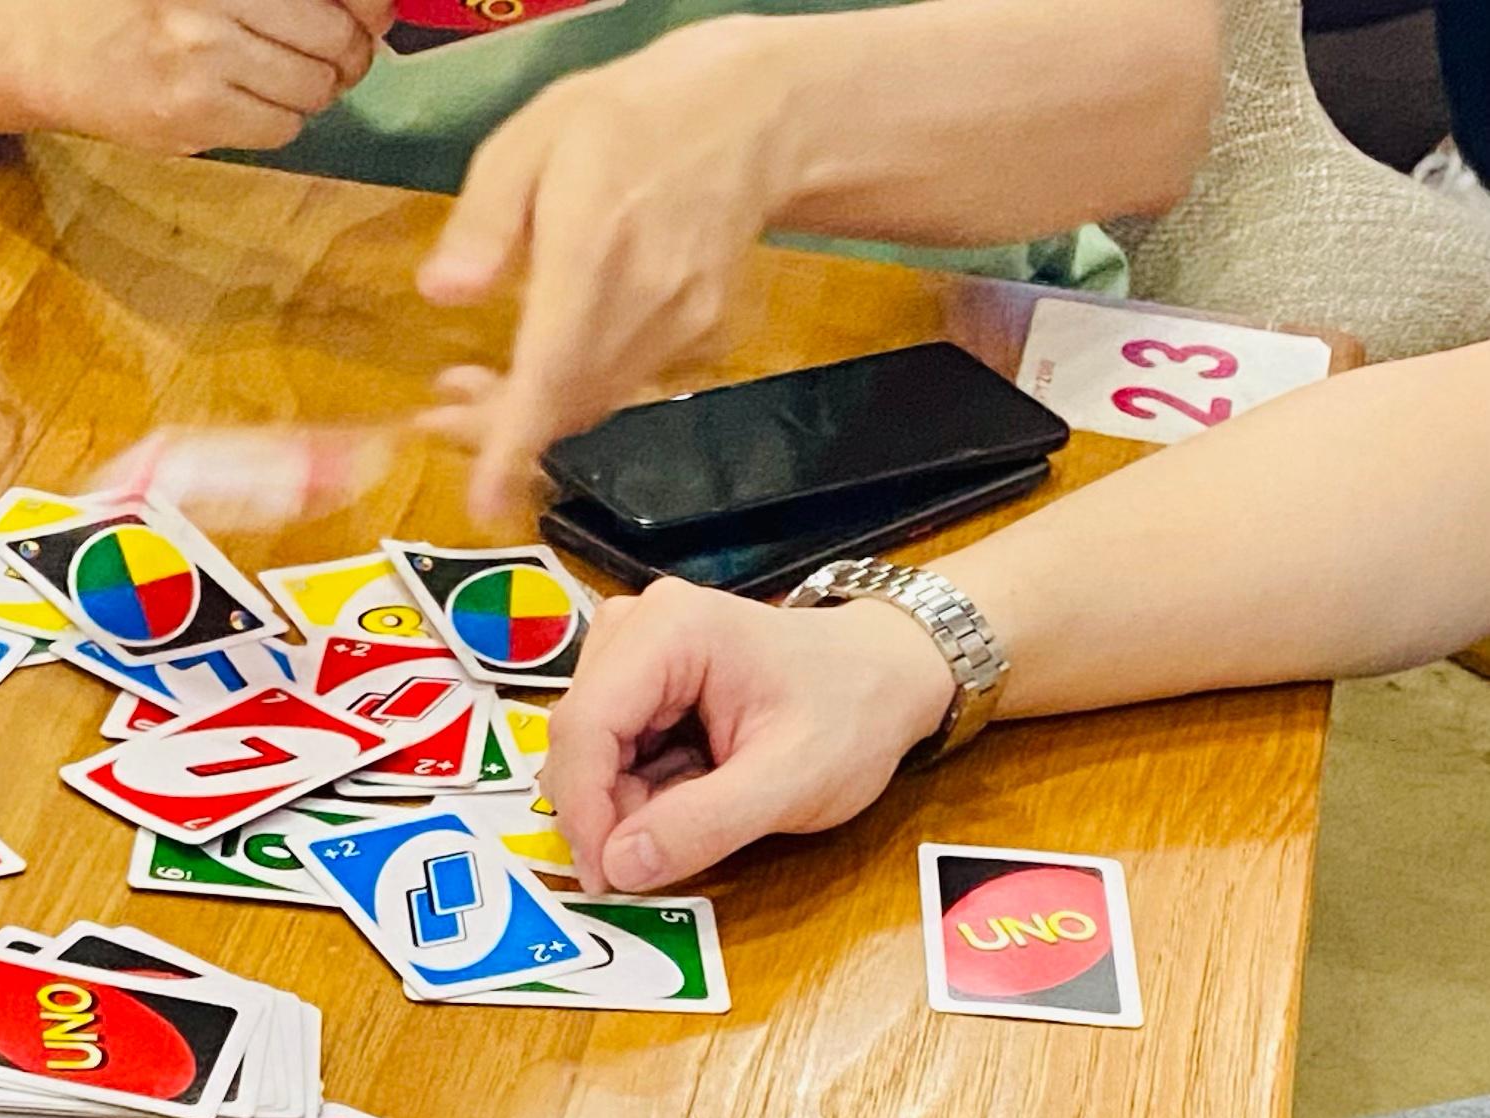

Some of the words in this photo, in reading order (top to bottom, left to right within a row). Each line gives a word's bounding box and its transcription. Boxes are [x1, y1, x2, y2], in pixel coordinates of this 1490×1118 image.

[1111, 339, 1239, 428] 23
[334, 643, 372, 657] +2
[186, 737, 298, 777] 7
[414, 759, 455, 775] +2
[324, 840, 360, 860] +2
[661, 911, 688, 924] 5
[957, 910, 1098, 951] UNO
[528, 940, 567, 962] +2
[36, 983, 103, 1071] UNO
